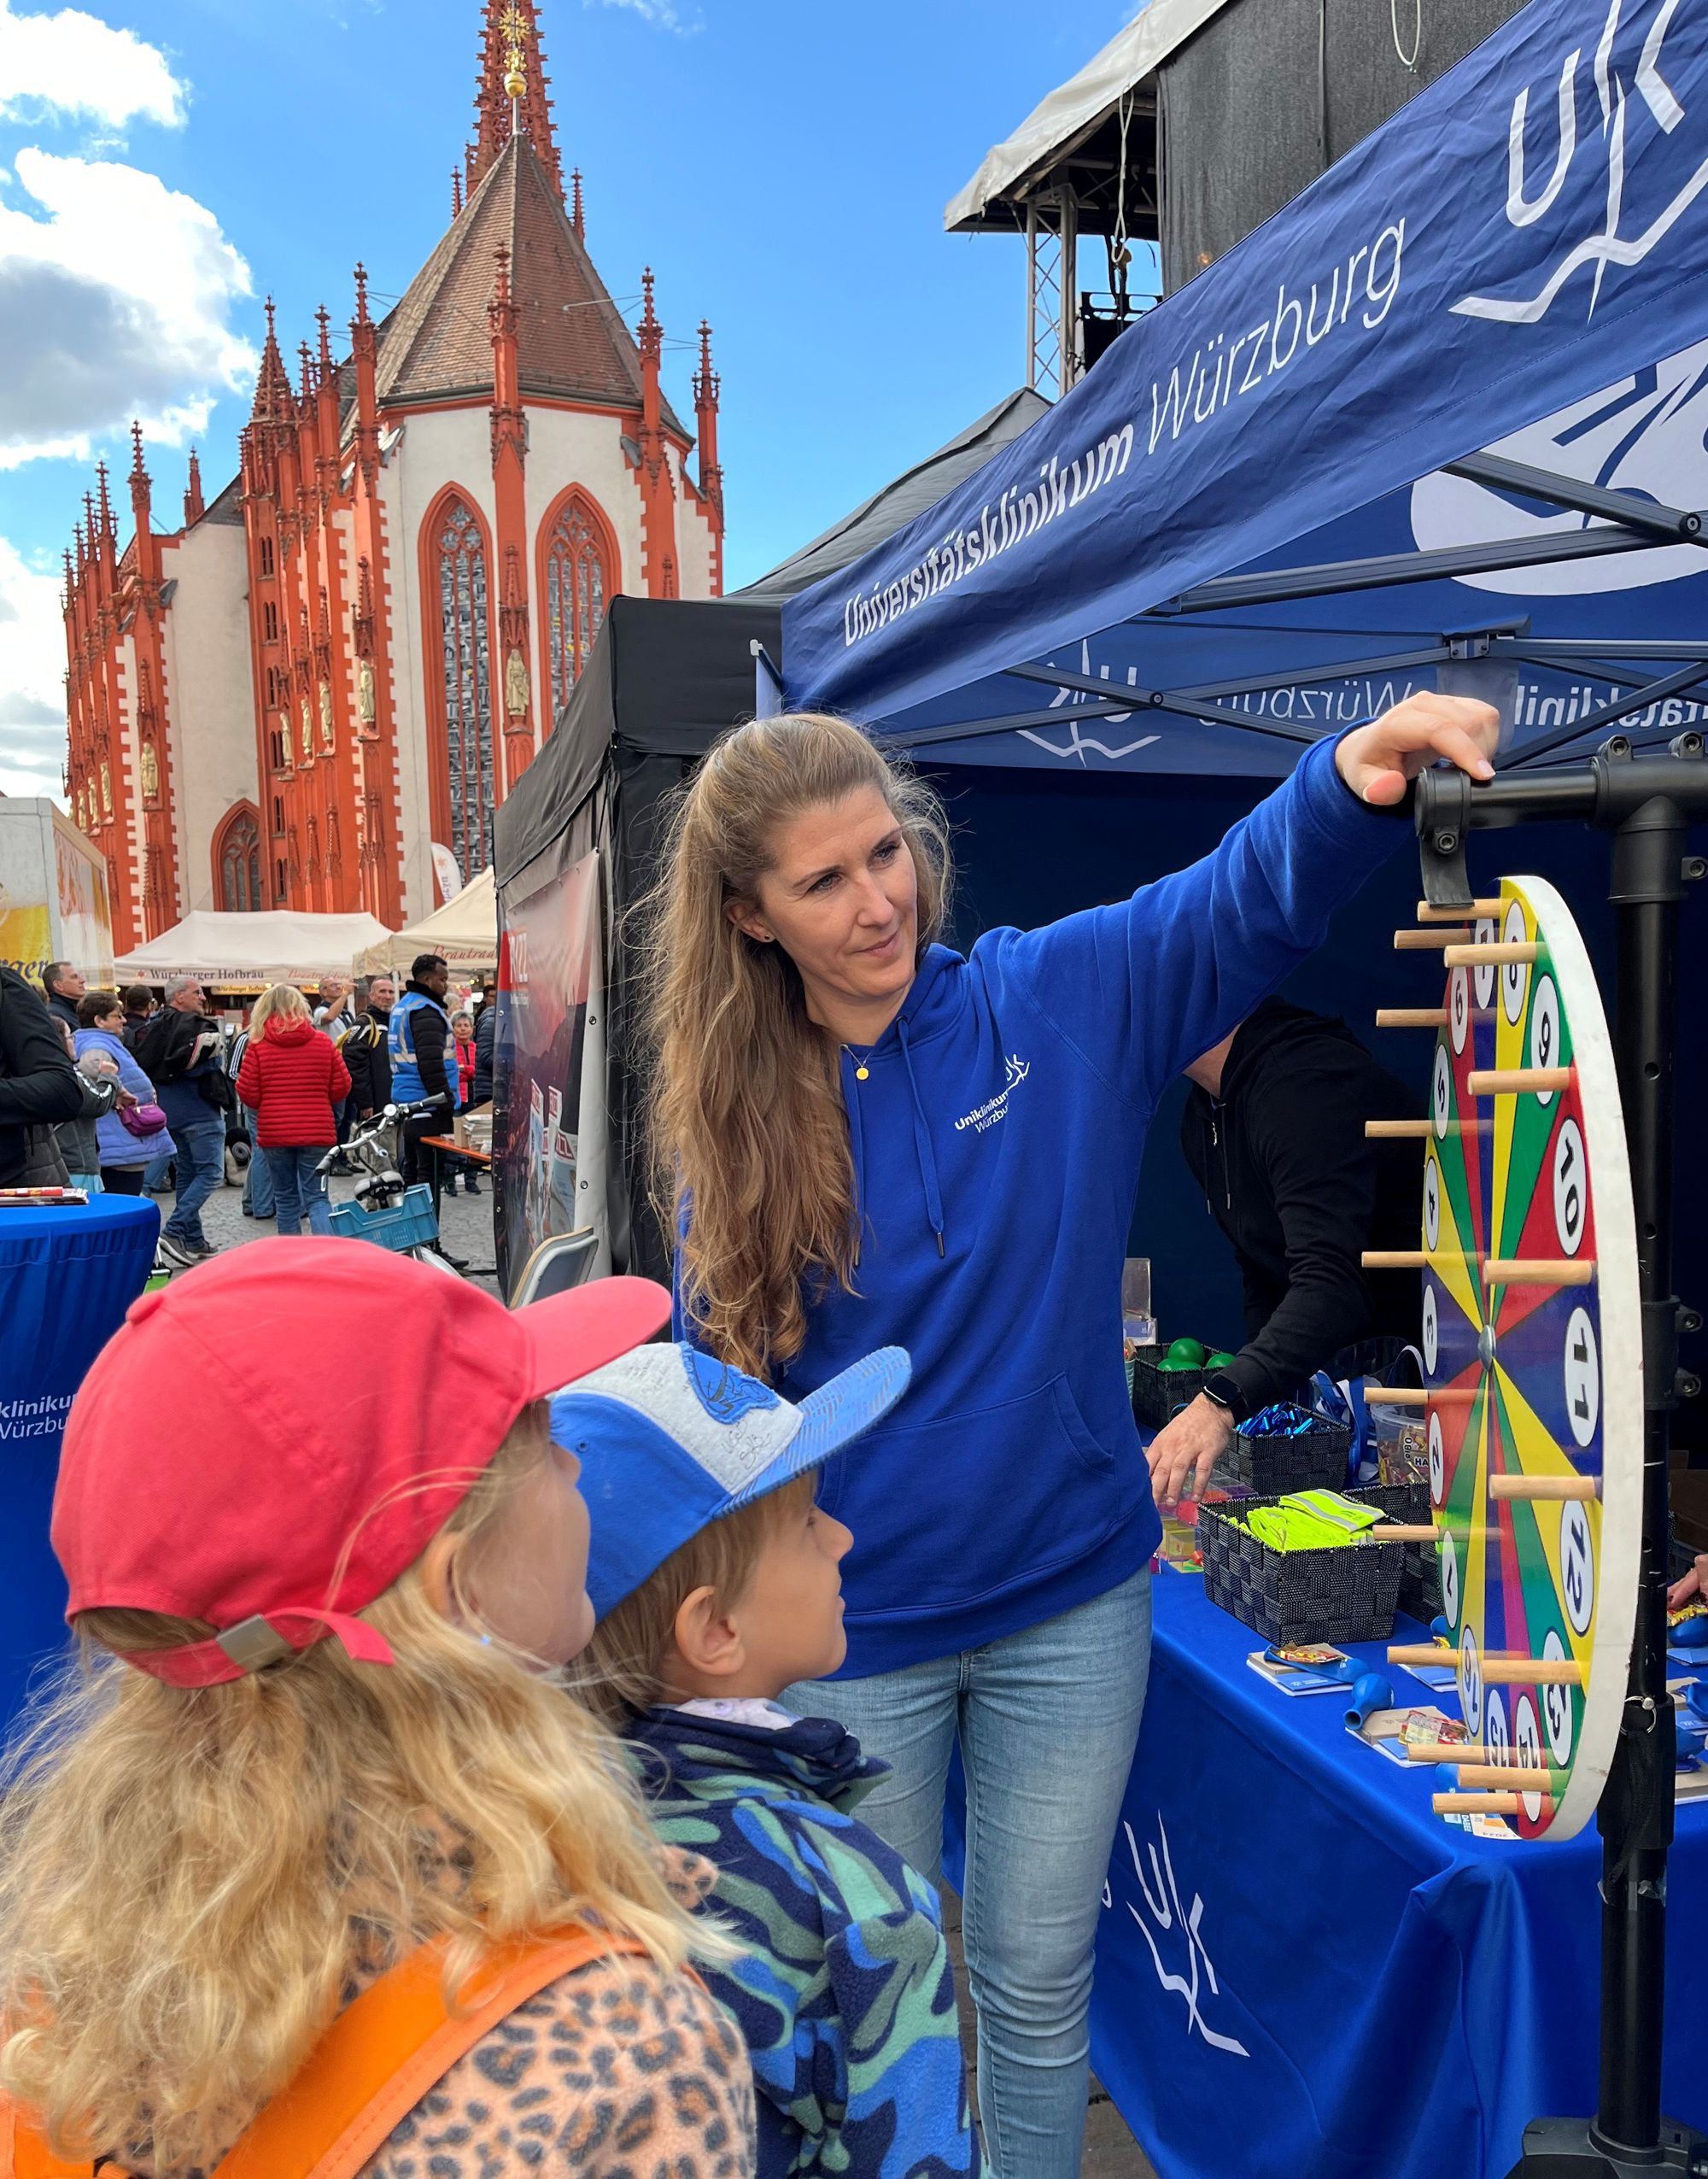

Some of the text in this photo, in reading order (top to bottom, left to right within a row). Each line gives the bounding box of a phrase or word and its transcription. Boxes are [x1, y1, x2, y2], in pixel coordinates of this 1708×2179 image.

[845, 424, 1134, 647] Universitätsklinikum
[1148, 217, 1406, 455] Würzburg
[219, 969, 264, 980] Hofbräu
[1455, 980, 1464, 1026] 6
[1538, 1010, 1552, 1069] 9
[1437, 1069, 1445, 1113] 5
[974, 1102, 1009, 1133] Würzbu
[1428, 1188, 1436, 1226] 4
[1560, 1136, 1580, 1238] 10
[1426, 1314, 1434, 1345] 3
[1573, 1327, 1590, 1420] 11
[0, 1394, 76, 1419] kliniku
[1432, 1437, 1440, 1477] 2
[1565, 1515, 1587, 1614] 12
[1463, 1643, 1478, 1713] 16
